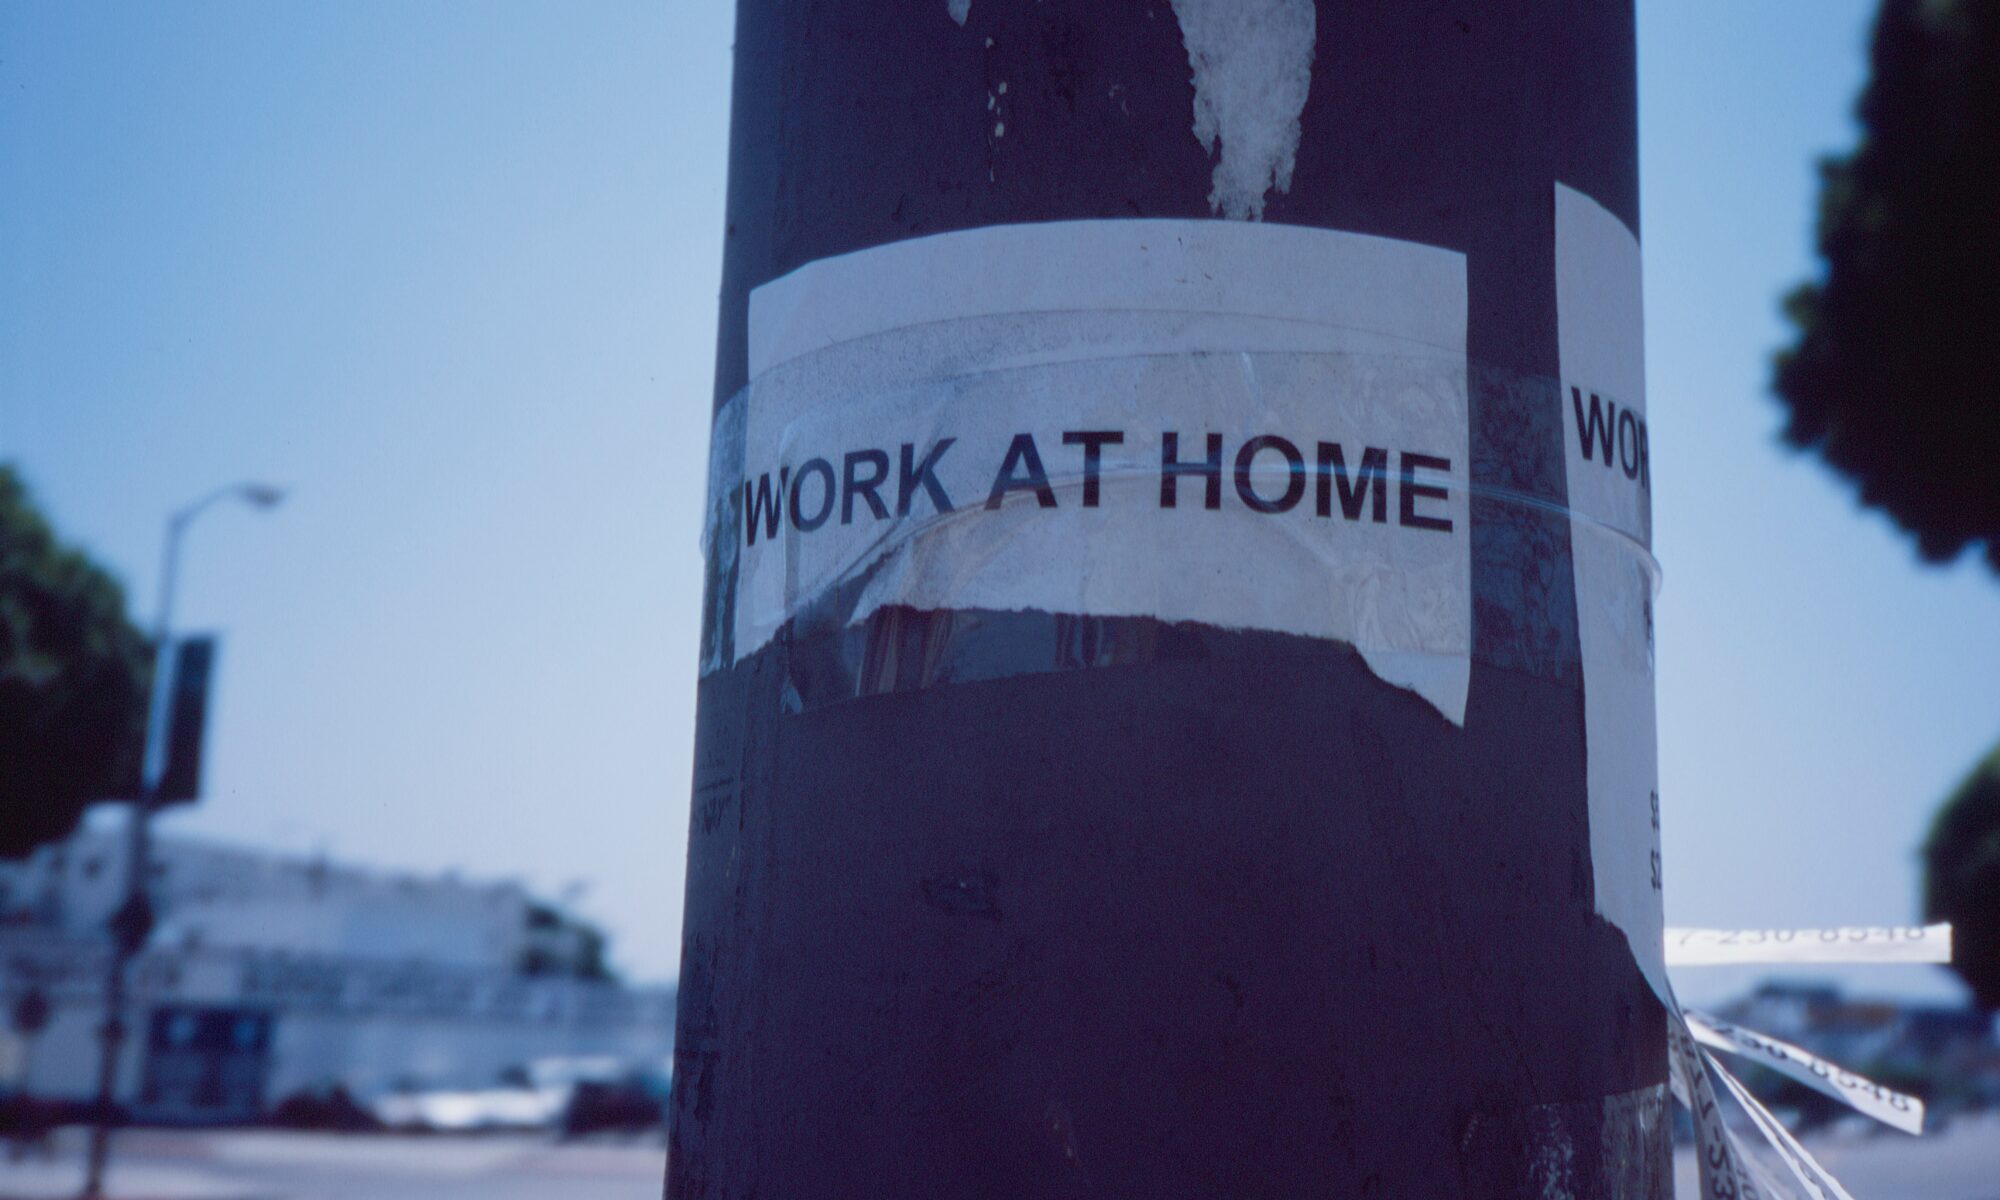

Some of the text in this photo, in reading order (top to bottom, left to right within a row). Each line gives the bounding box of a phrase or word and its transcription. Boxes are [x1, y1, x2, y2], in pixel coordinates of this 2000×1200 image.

[744, 430, 1454, 547] WORK AT HOME
